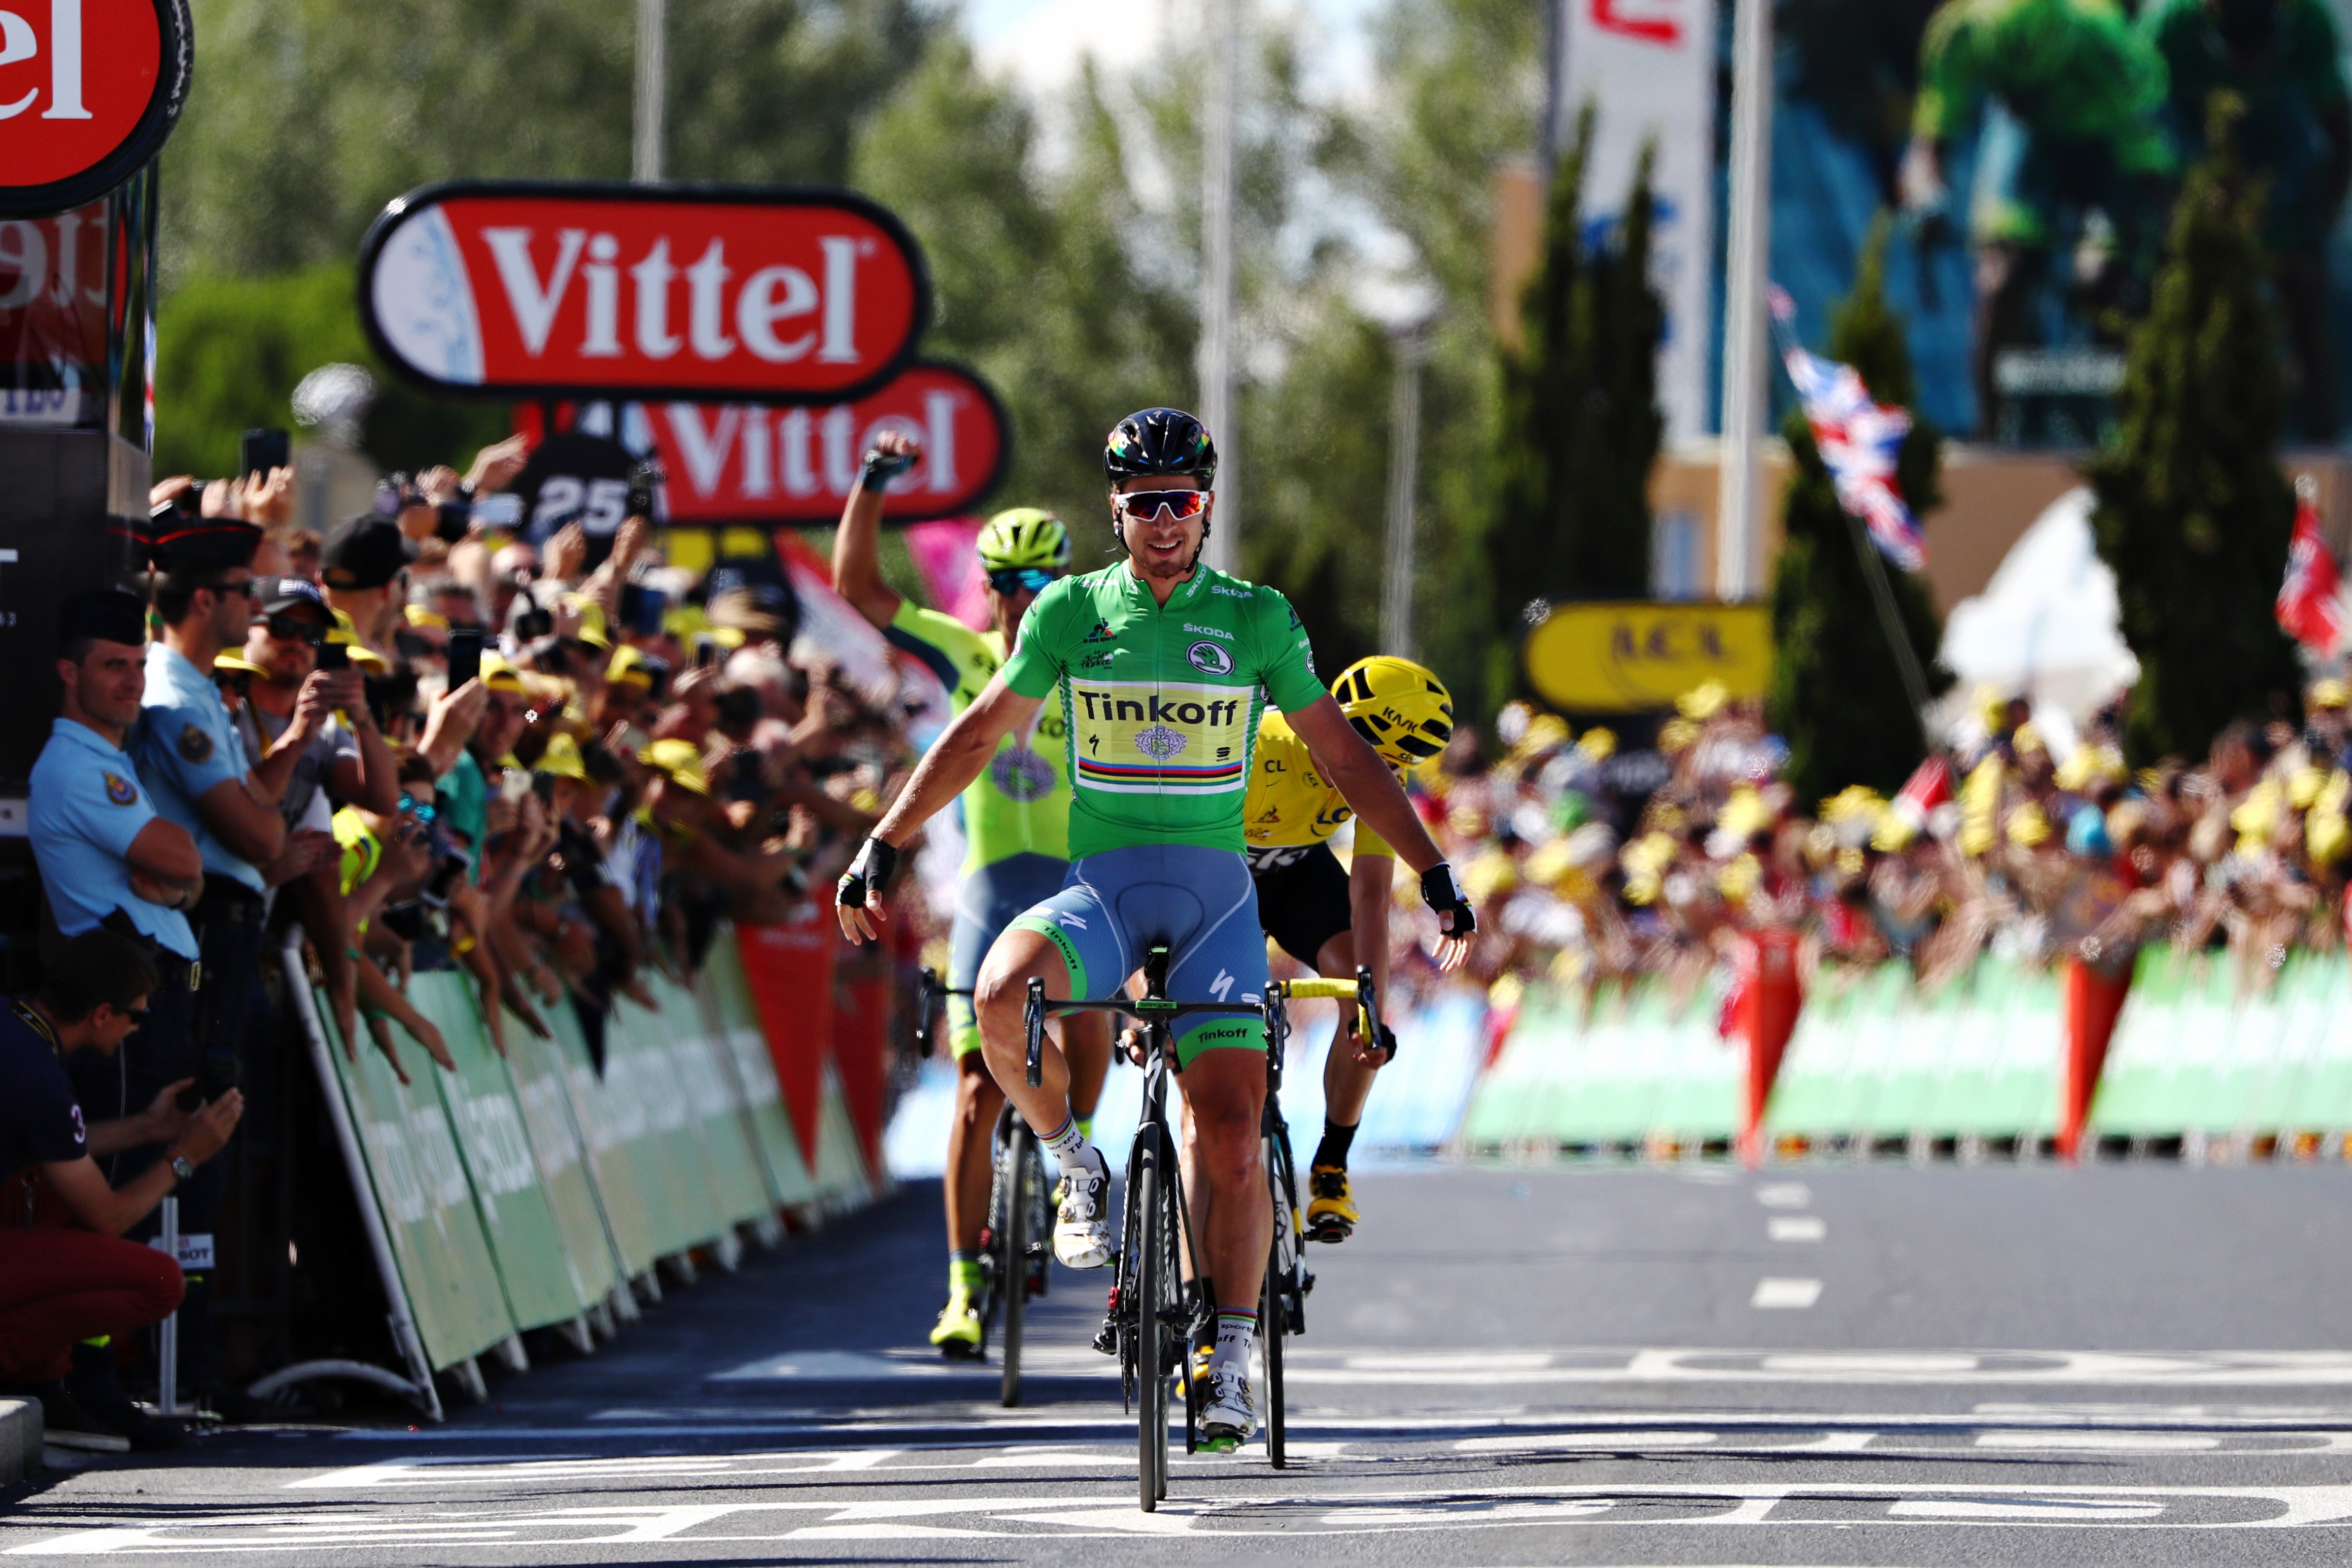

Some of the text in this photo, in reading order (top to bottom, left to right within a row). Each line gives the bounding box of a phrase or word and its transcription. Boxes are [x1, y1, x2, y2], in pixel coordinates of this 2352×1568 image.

[479, 226, 860, 364] Vittel
[532, 475, 629, 538] 25
[1183, 622, 1235, 641] ŠKODA
[1078, 690, 1238, 726] Tinkoff
[1044, 925, 1078, 970] Tinkoff
[1198, 1028, 1248, 1043] Tinkoff
